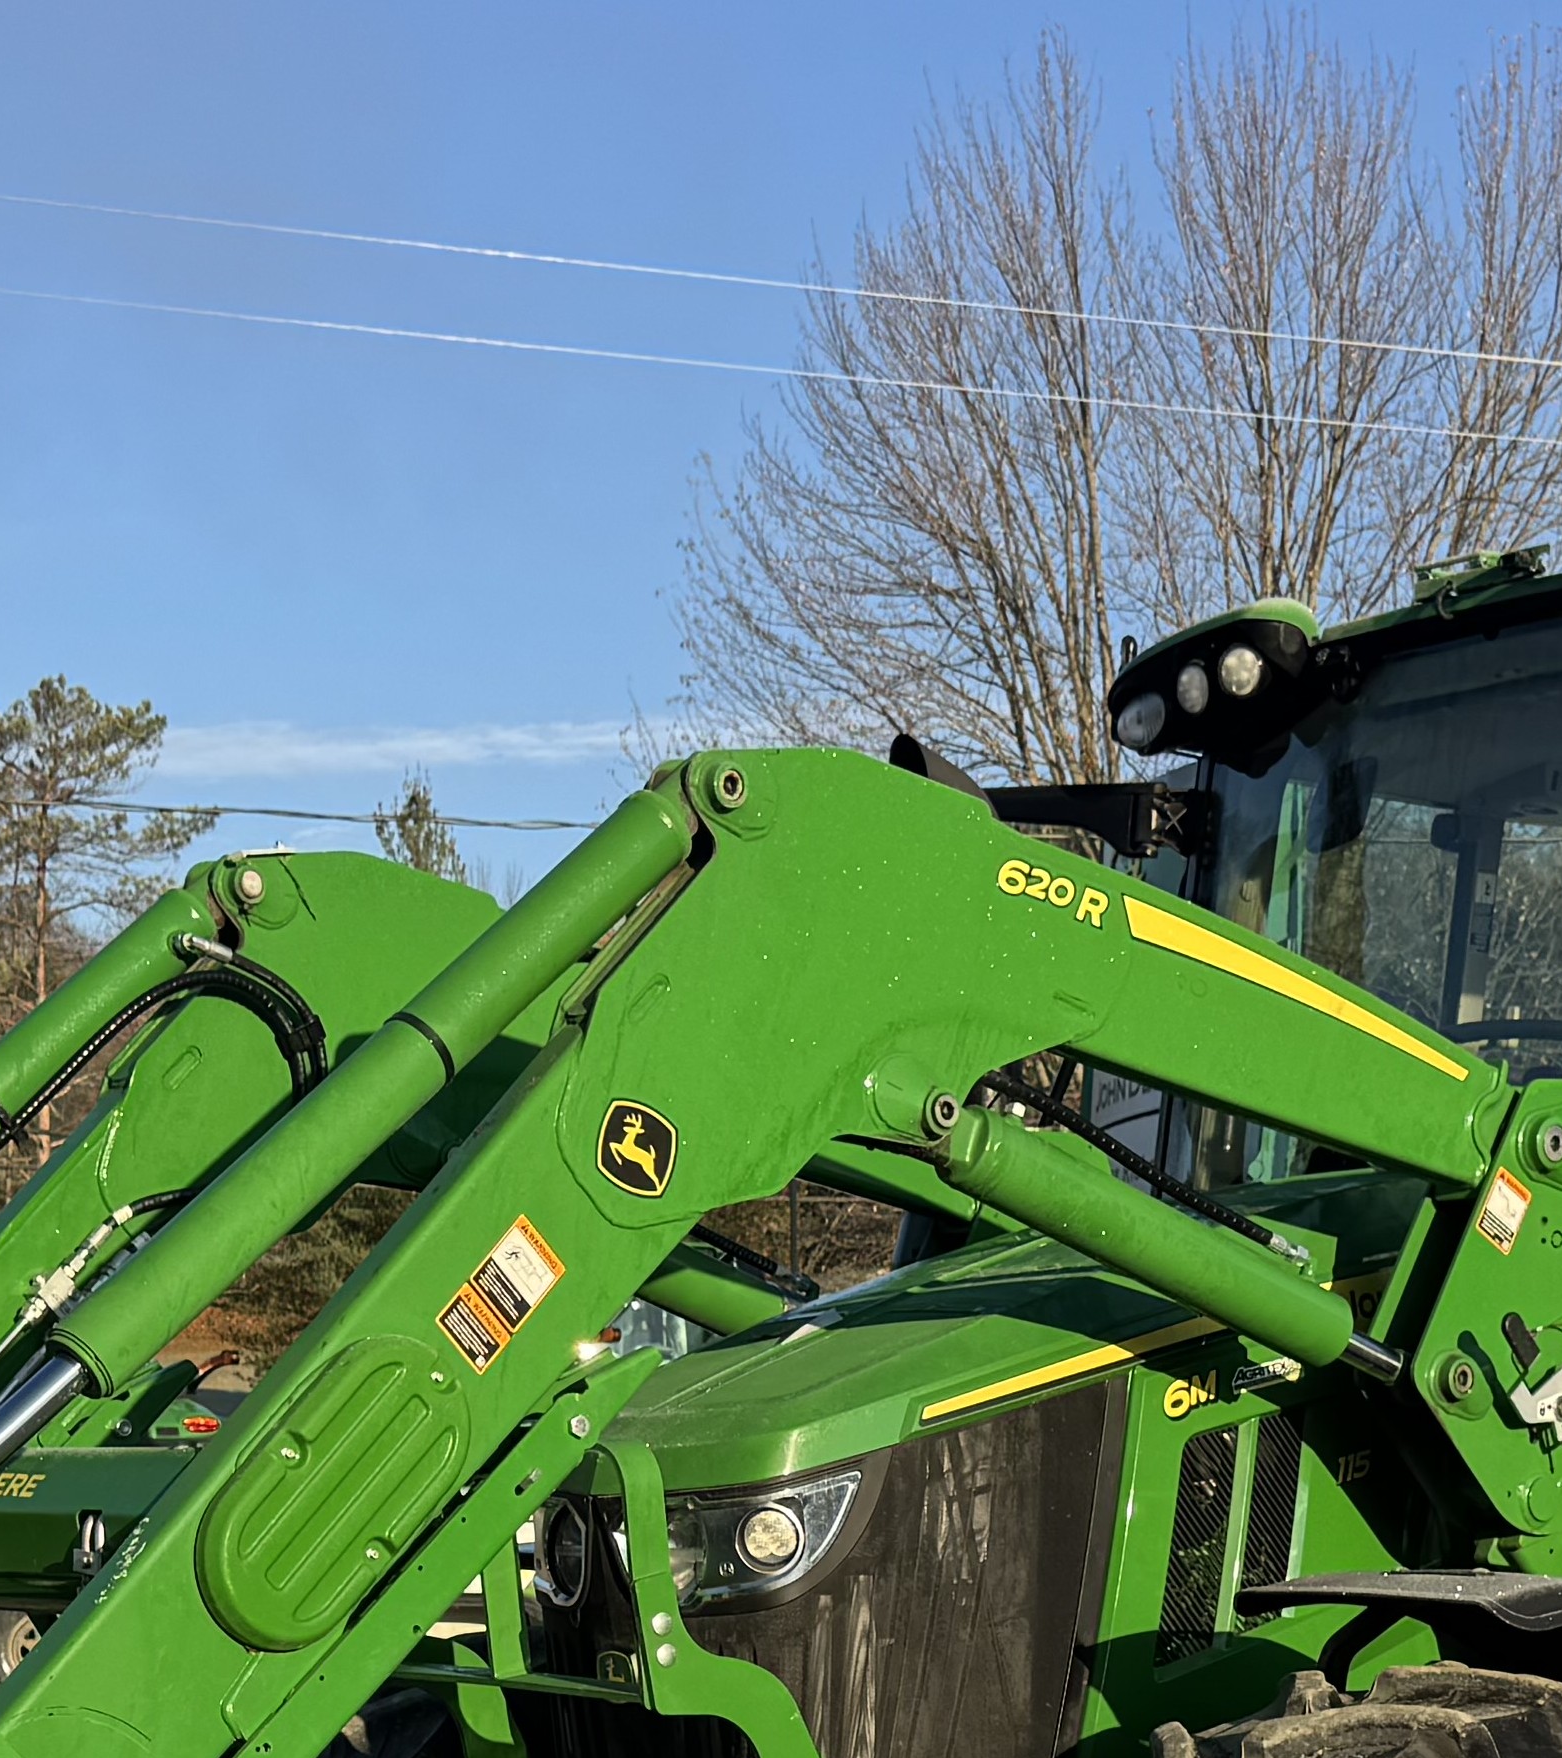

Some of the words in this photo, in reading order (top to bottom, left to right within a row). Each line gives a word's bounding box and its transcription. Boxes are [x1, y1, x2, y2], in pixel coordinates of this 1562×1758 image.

[997, 858, 1076, 908] 620
[1075, 886, 1110, 929] R
[1163, 1369, 1217, 1418] 6M
